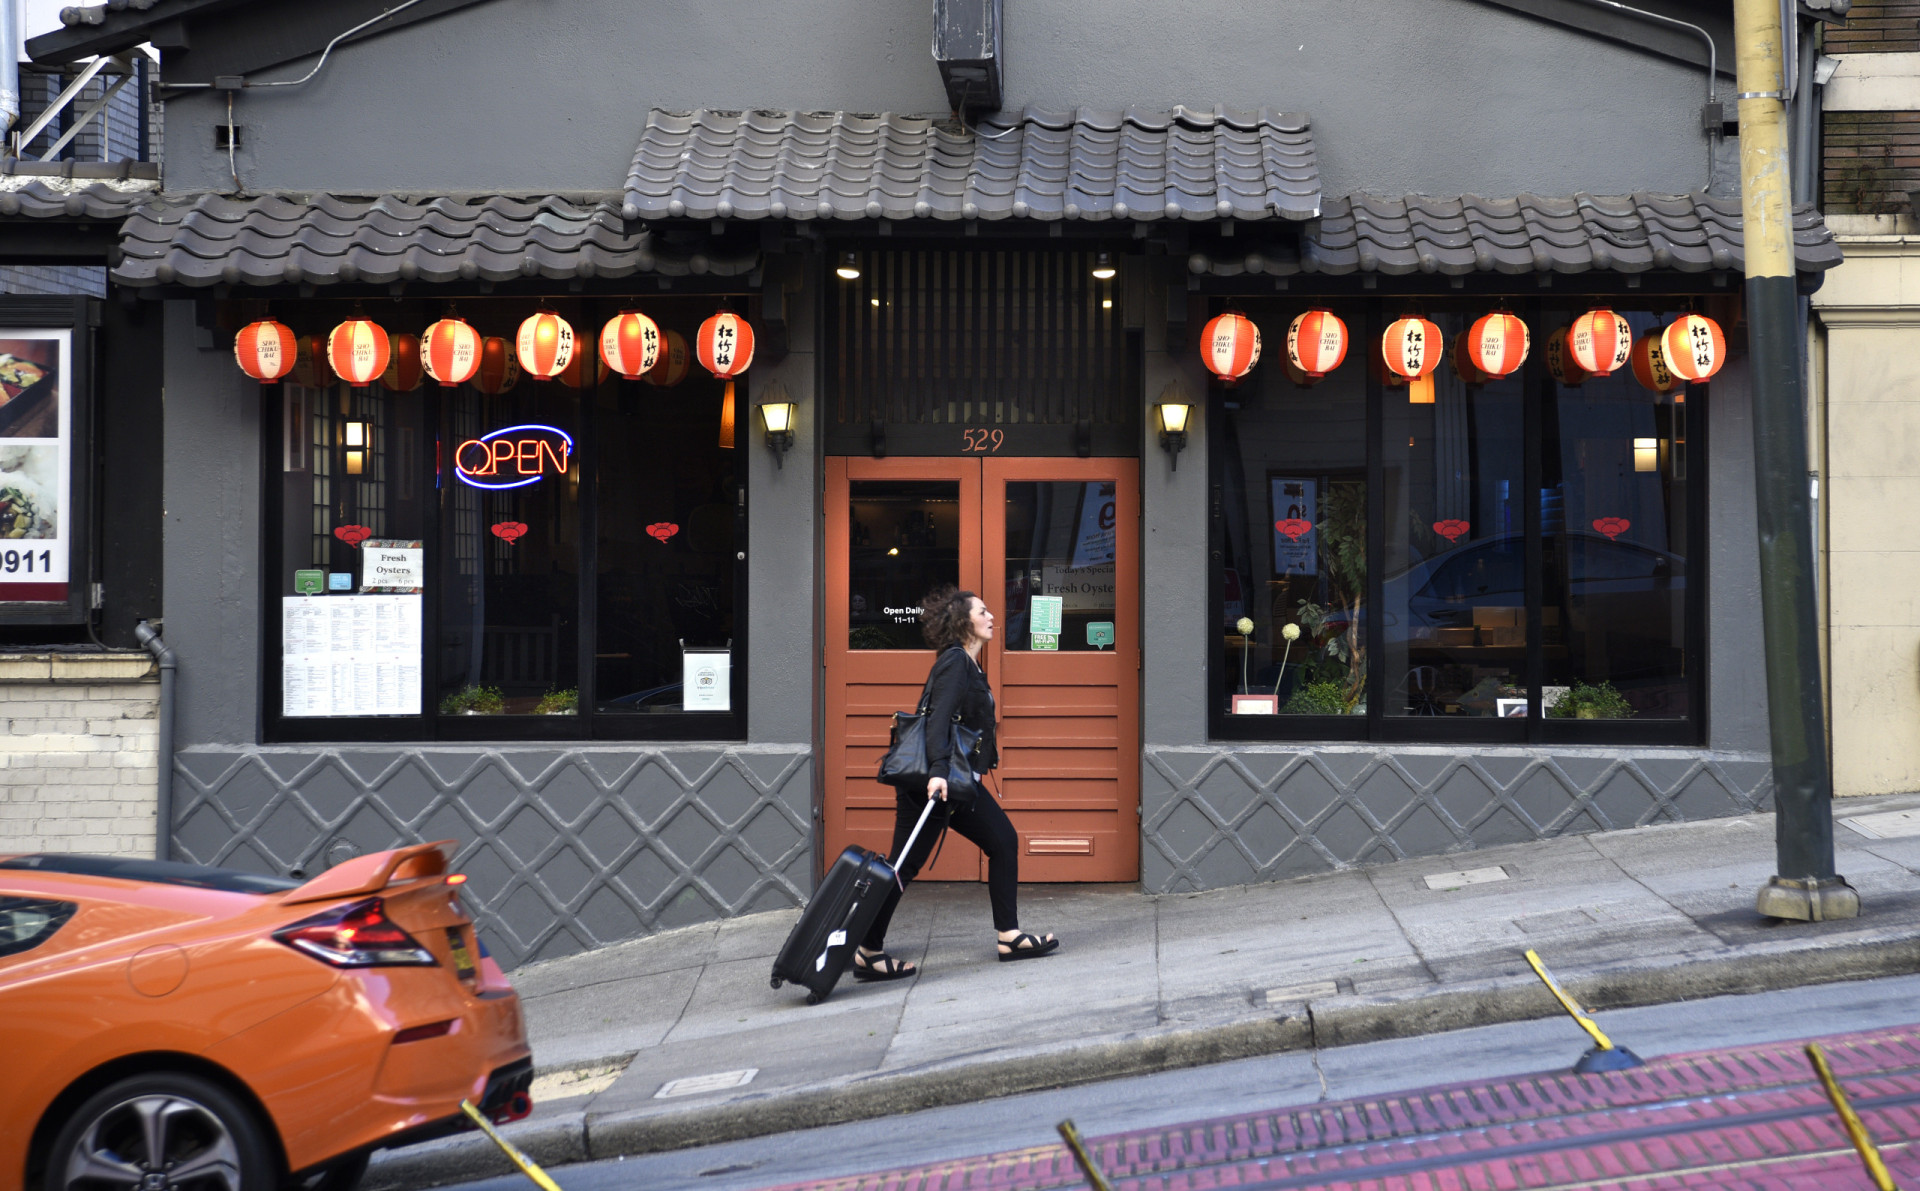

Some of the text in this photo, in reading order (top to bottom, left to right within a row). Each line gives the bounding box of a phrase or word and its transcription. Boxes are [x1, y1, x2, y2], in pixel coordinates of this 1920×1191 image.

[961, 428, 1004, 453] 529
[455, 439, 568, 475] OPEN
[0, 549, 51, 573] 911
[381, 554, 407, 562] Fresh
[376, 566, 411, 575] Oysters
[1047, 583, 1078, 594] Fresh
[883, 606, 925, 615] Open Daily
